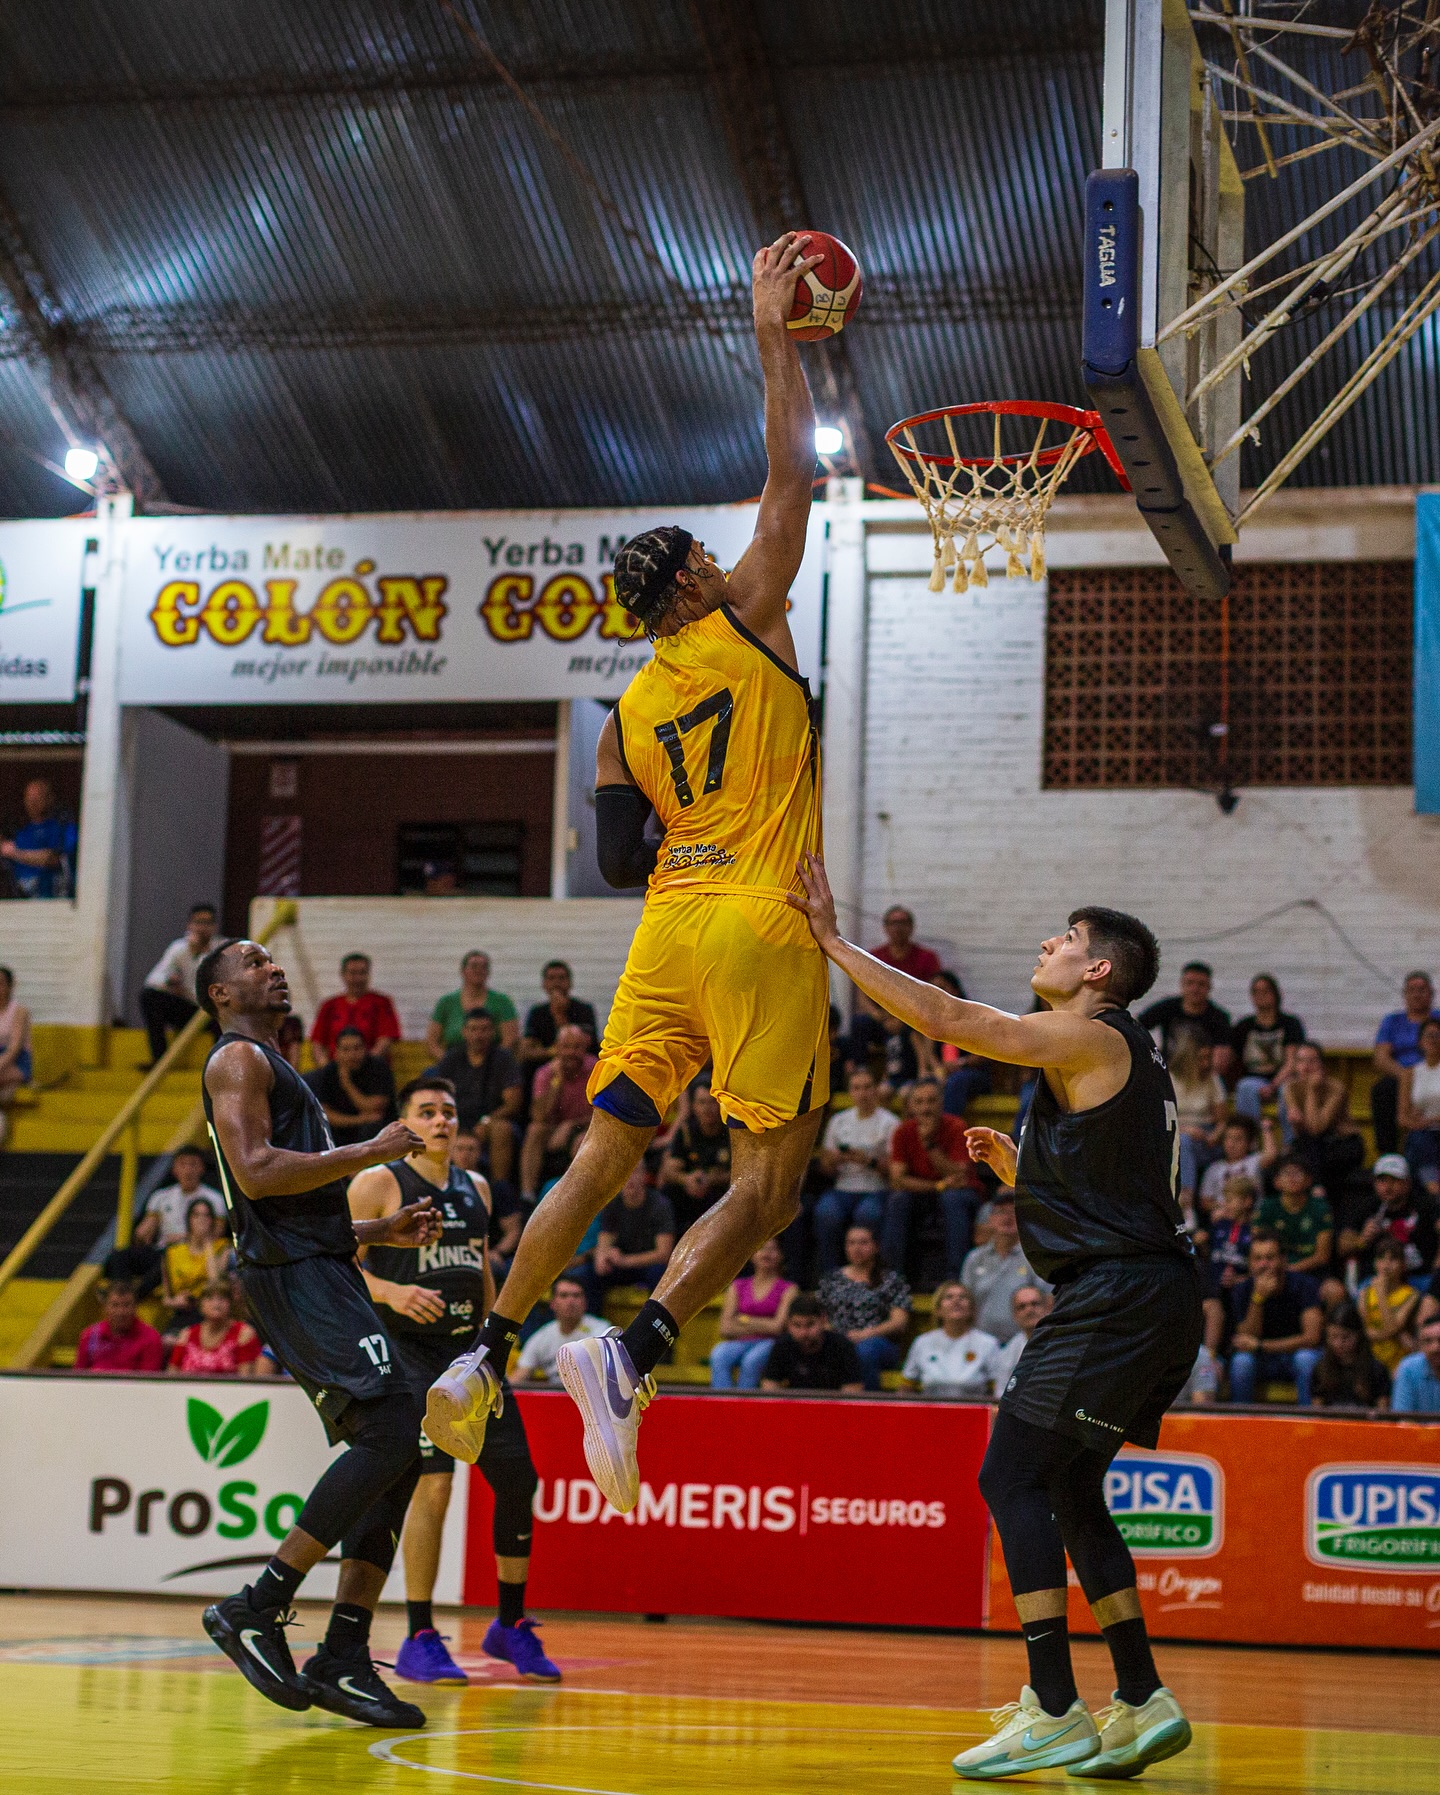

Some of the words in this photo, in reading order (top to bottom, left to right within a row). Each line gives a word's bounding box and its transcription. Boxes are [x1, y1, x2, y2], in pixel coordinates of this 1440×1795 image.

[1098, 224, 1116, 287] TAGUA
[153, 544, 249, 572] Yerba
[262, 543, 346, 571] Mate
[483, 536, 585, 567] Yerba
[148, 558, 449, 647] COLÓN
[479, 572, 652, 643] COL
[0, 656, 48, 677] idas
[231, 654, 309, 683] mejor
[317, 649, 449, 684] imposible
[567, 646, 650, 680] mejor
[653, 687, 735, 809] 17
[443, 1202, 457, 1219] 5
[418, 1238, 483, 1273] KINGS
[358, 1333, 390, 1366] 17
[90, 1476, 304, 1541] ProSo
[532, 1477, 797, 1533] UDAMERIS
[811, 1497, 946, 1529] SEGUROS
[1103, 1469, 1203, 1514] PISA
[1331, 1483, 1440, 1526] UPIS
[1118, 1521, 1201, 1543] ORÍFICO
